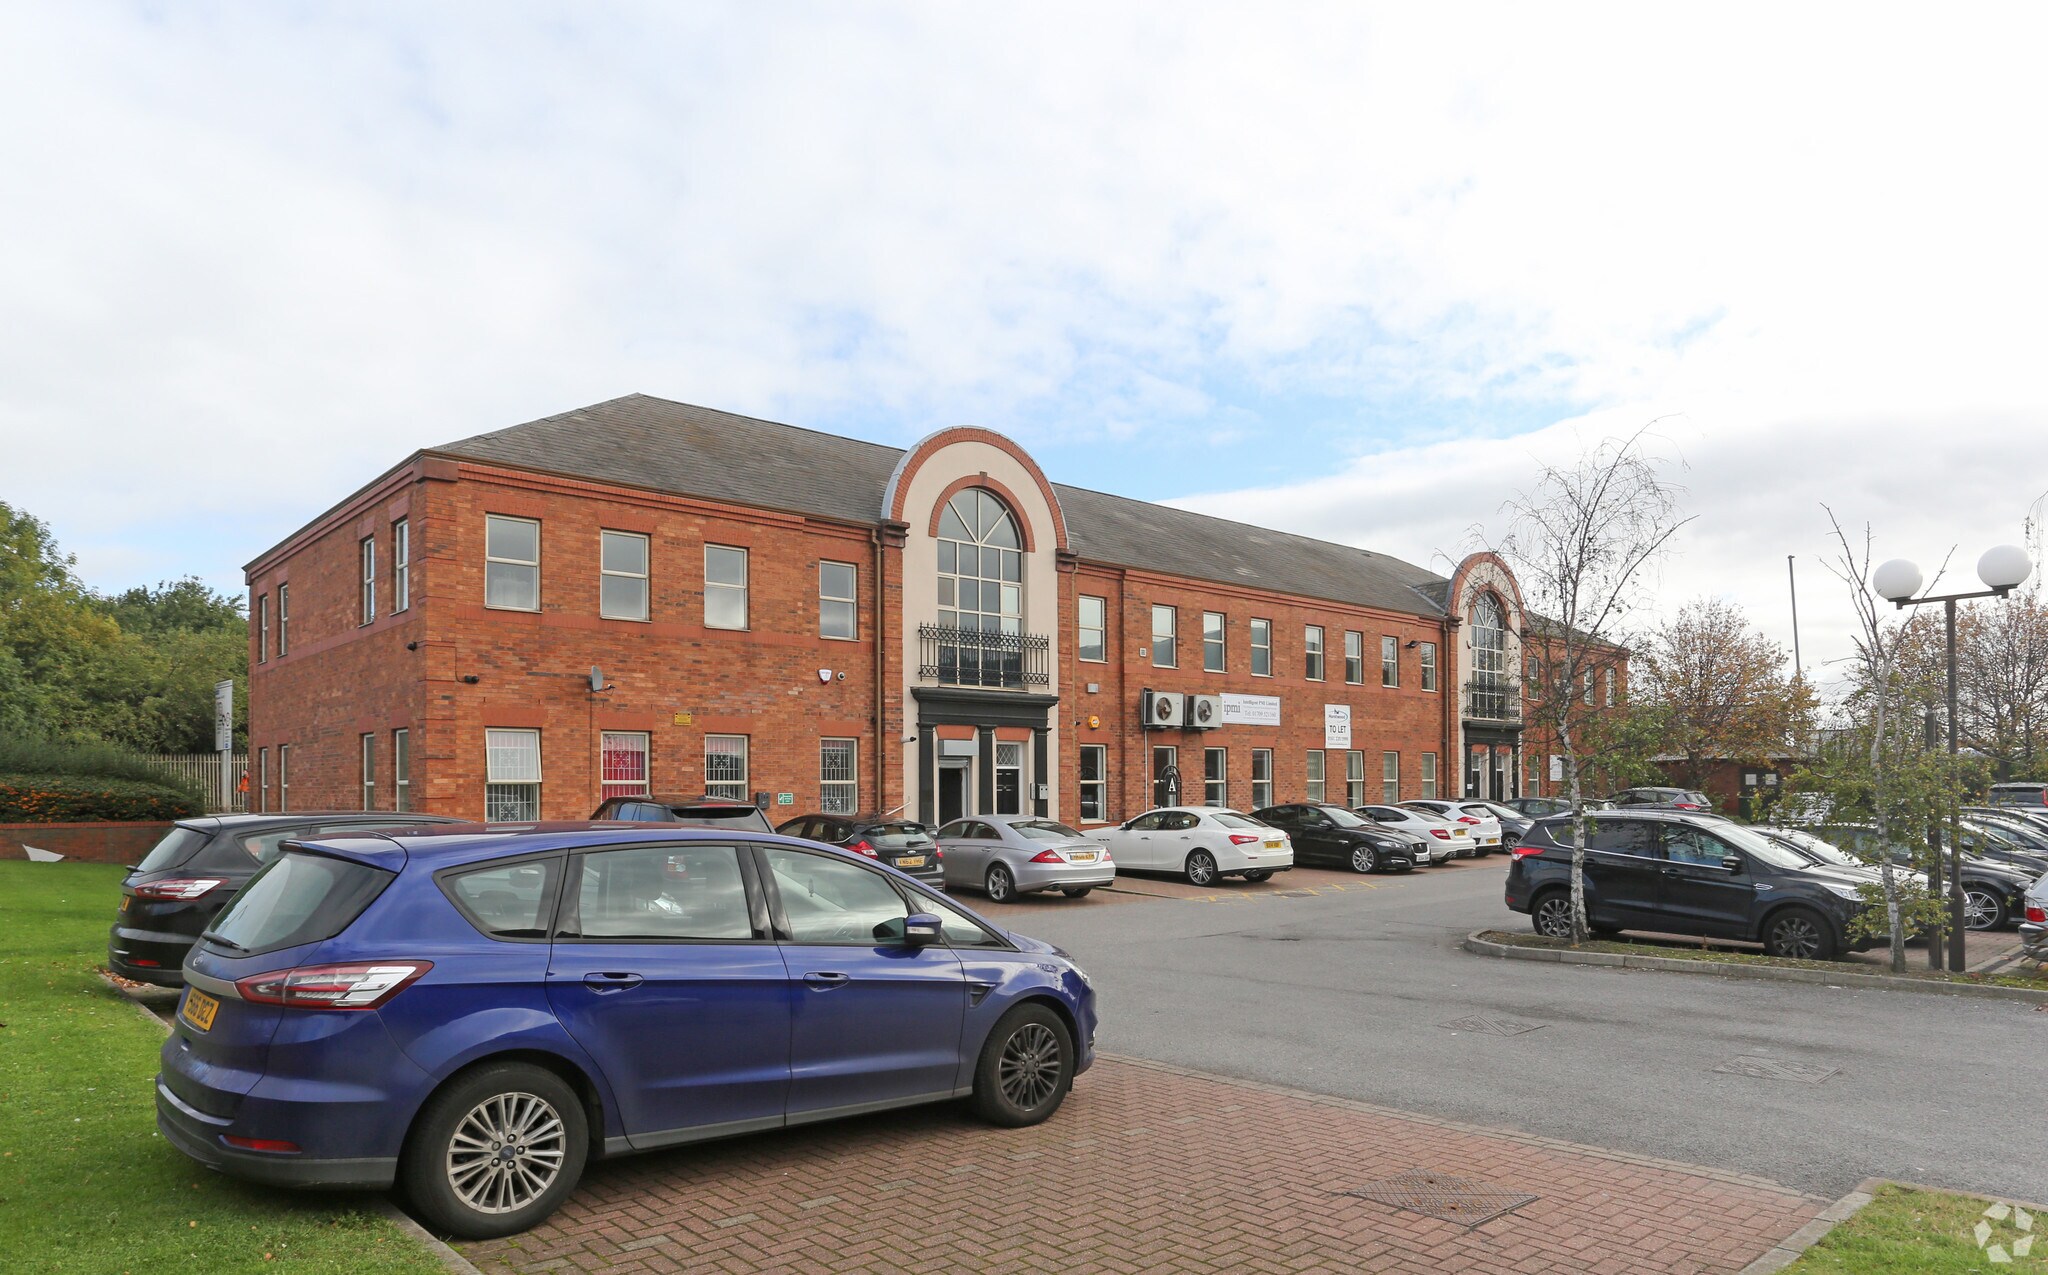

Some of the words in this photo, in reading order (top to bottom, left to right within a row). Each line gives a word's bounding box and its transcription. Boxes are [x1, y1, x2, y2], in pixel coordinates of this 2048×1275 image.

[1223, 701, 1241, 715] ipmi
[1329, 725, 1337, 733] TO
[1338, 725, 1346, 733] LET
[1168, 777, 1176, 792] A
